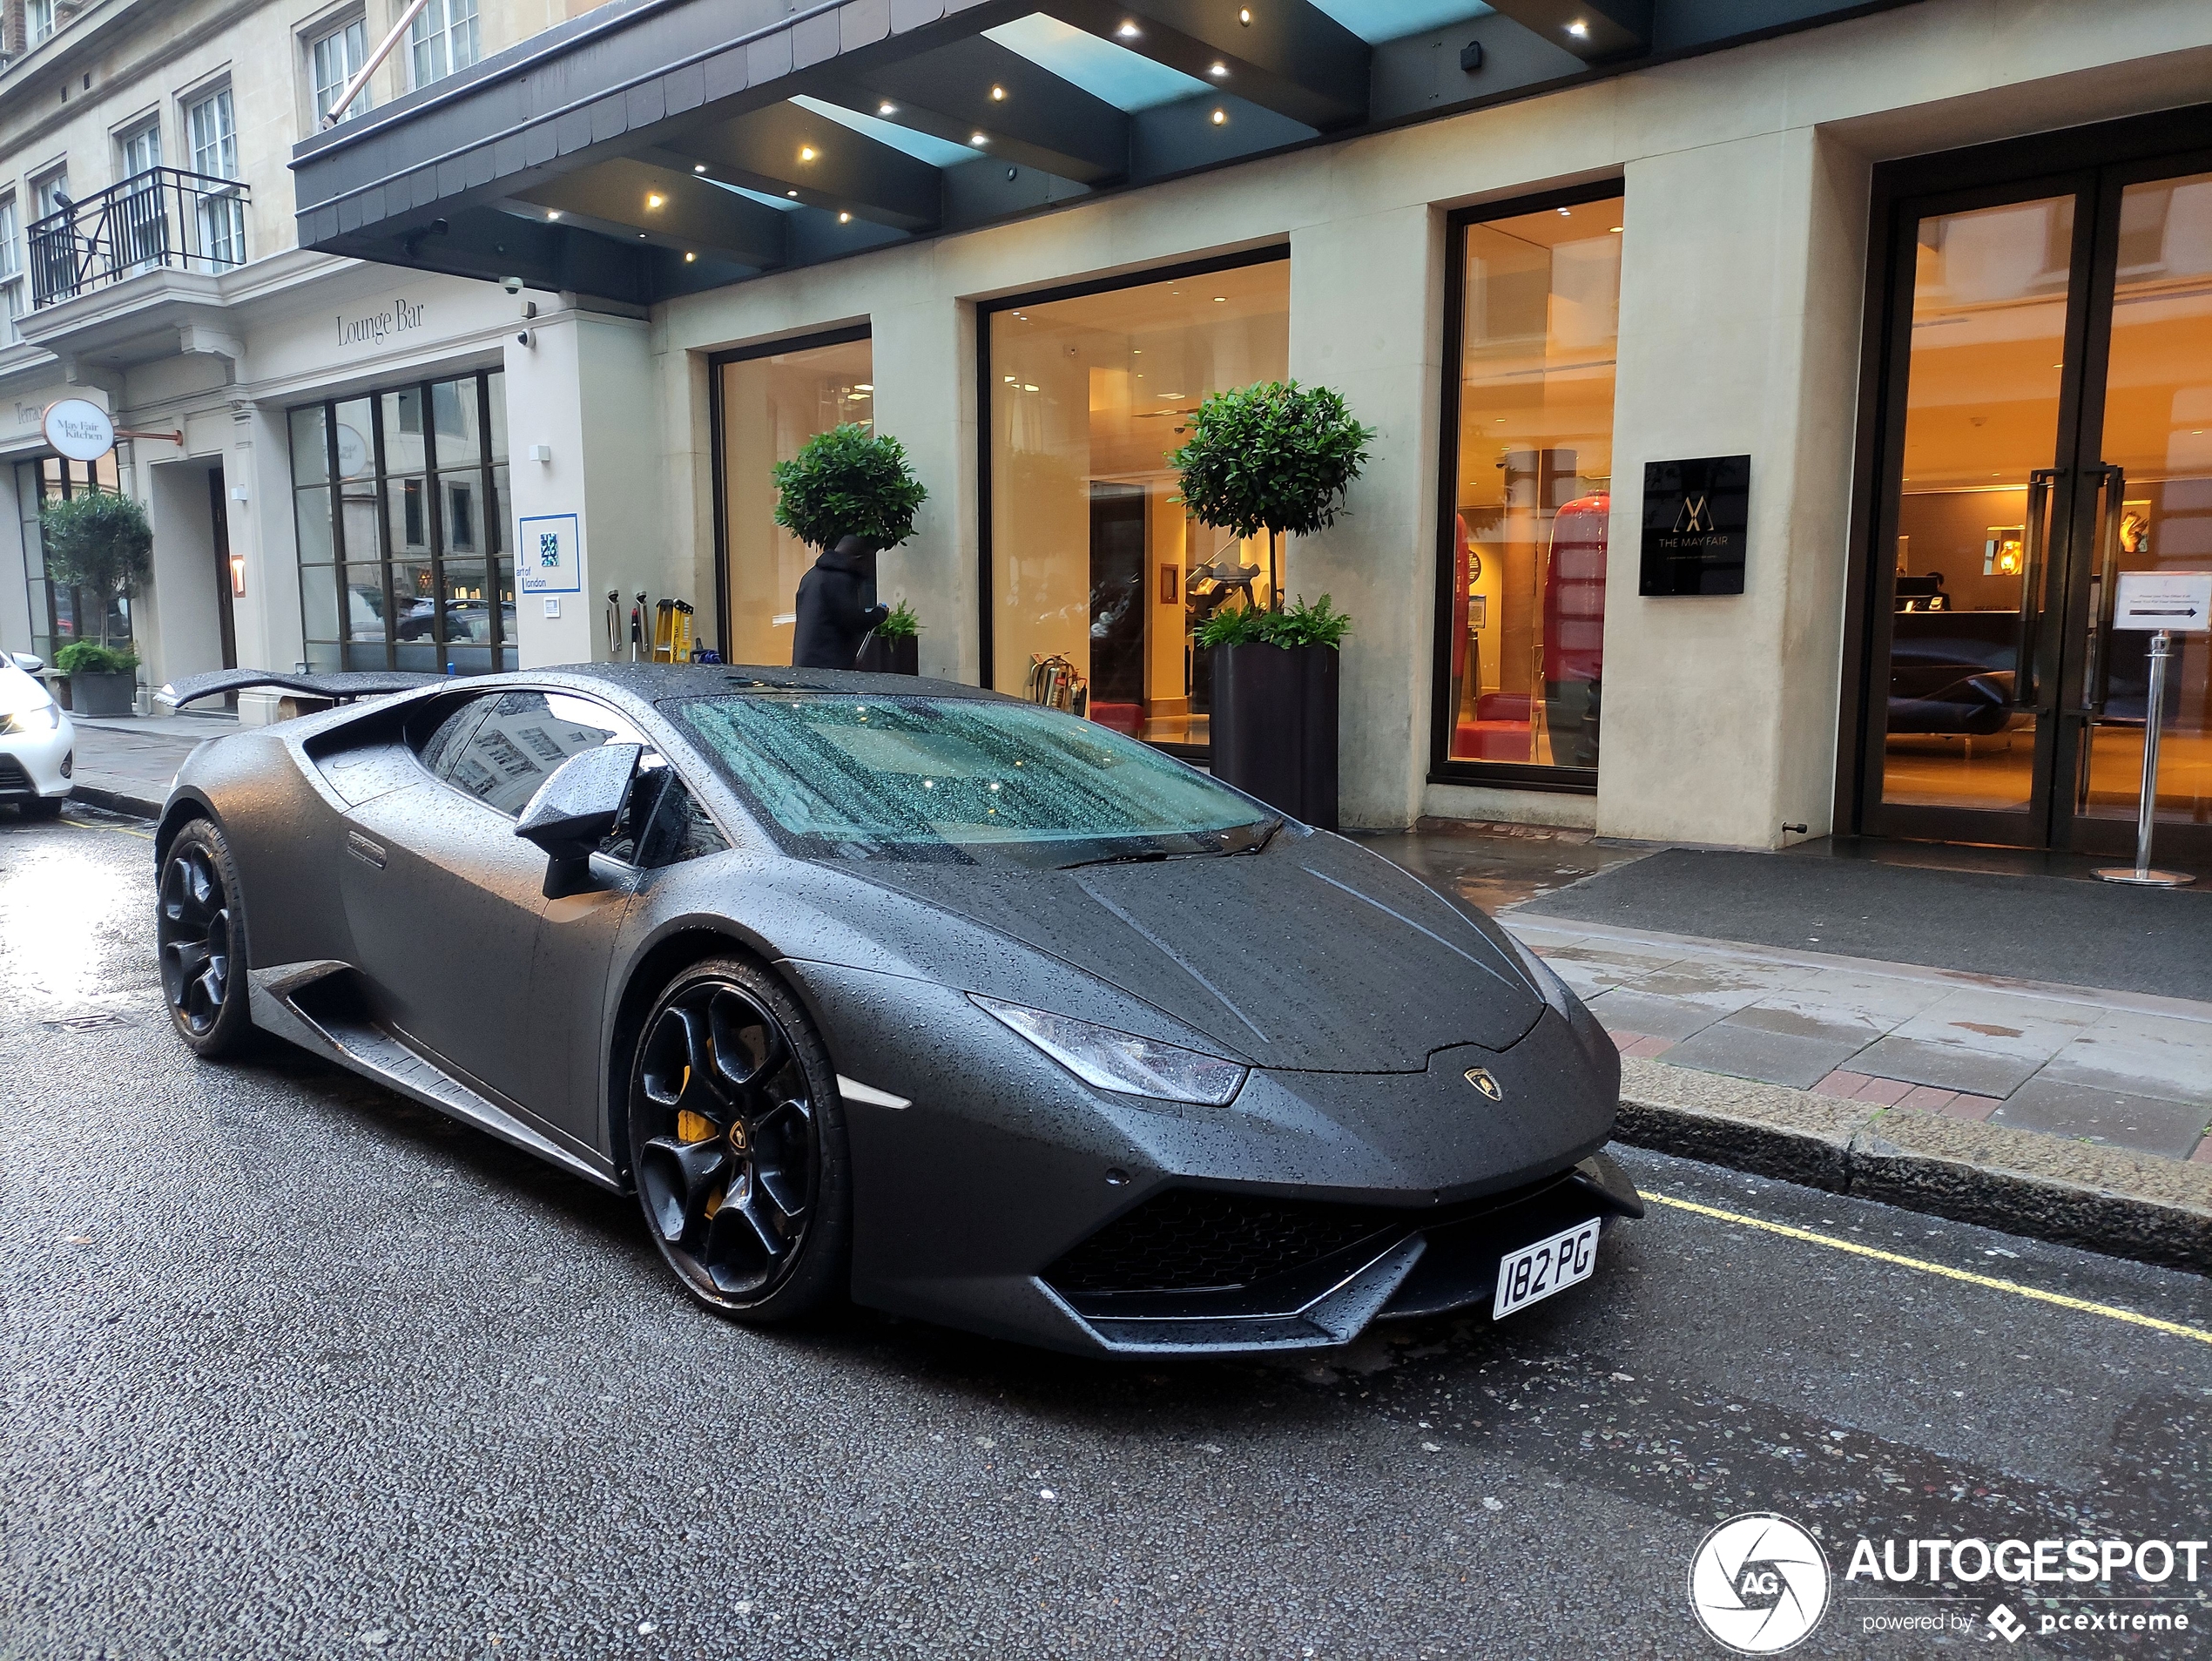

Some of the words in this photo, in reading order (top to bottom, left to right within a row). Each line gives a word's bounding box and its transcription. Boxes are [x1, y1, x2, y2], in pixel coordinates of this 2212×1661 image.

[336, 313, 392, 346] Lounge
[395, 299, 424, 332] Bar
[15, 402, 45, 424] Terrac
[57, 419, 78, 430] May
[80, 422, 98, 431] Fair
[65, 429, 103, 440] Kitchen
[1659, 538, 1678, 548] THE
[1681, 537, 1704, 547] MAY
[1706, 536, 1729, 545] FAIR
[525, 566, 530, 576] of
[525, 577, 546, 588] london
[1503, 1248, 1550, 1308] 182
[1554, 1230, 1591, 1285] PG
